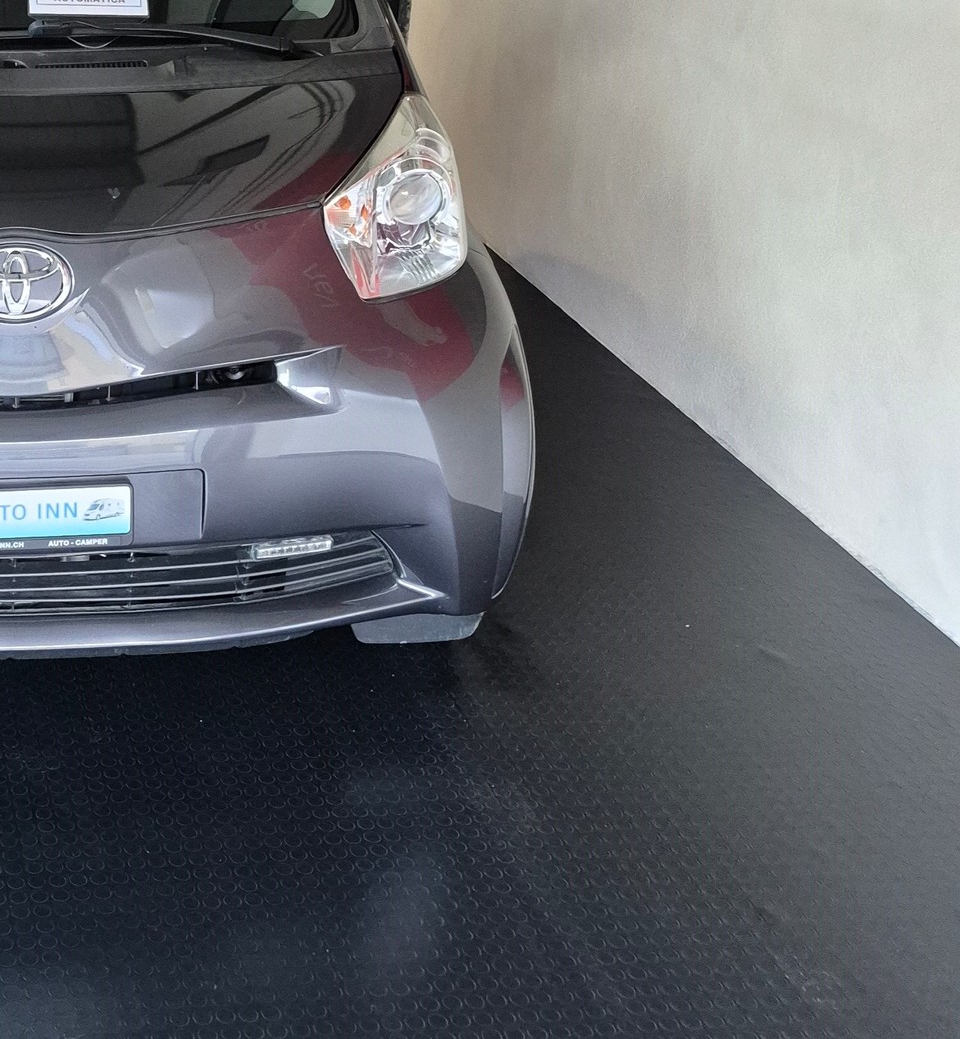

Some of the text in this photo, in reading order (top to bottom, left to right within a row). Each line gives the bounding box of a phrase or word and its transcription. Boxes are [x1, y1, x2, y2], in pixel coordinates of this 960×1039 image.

[37, 502, 79, 520] INN
[48, 539, 69, 547] AUTO
[75, 538, 108, 546] CAMPER
